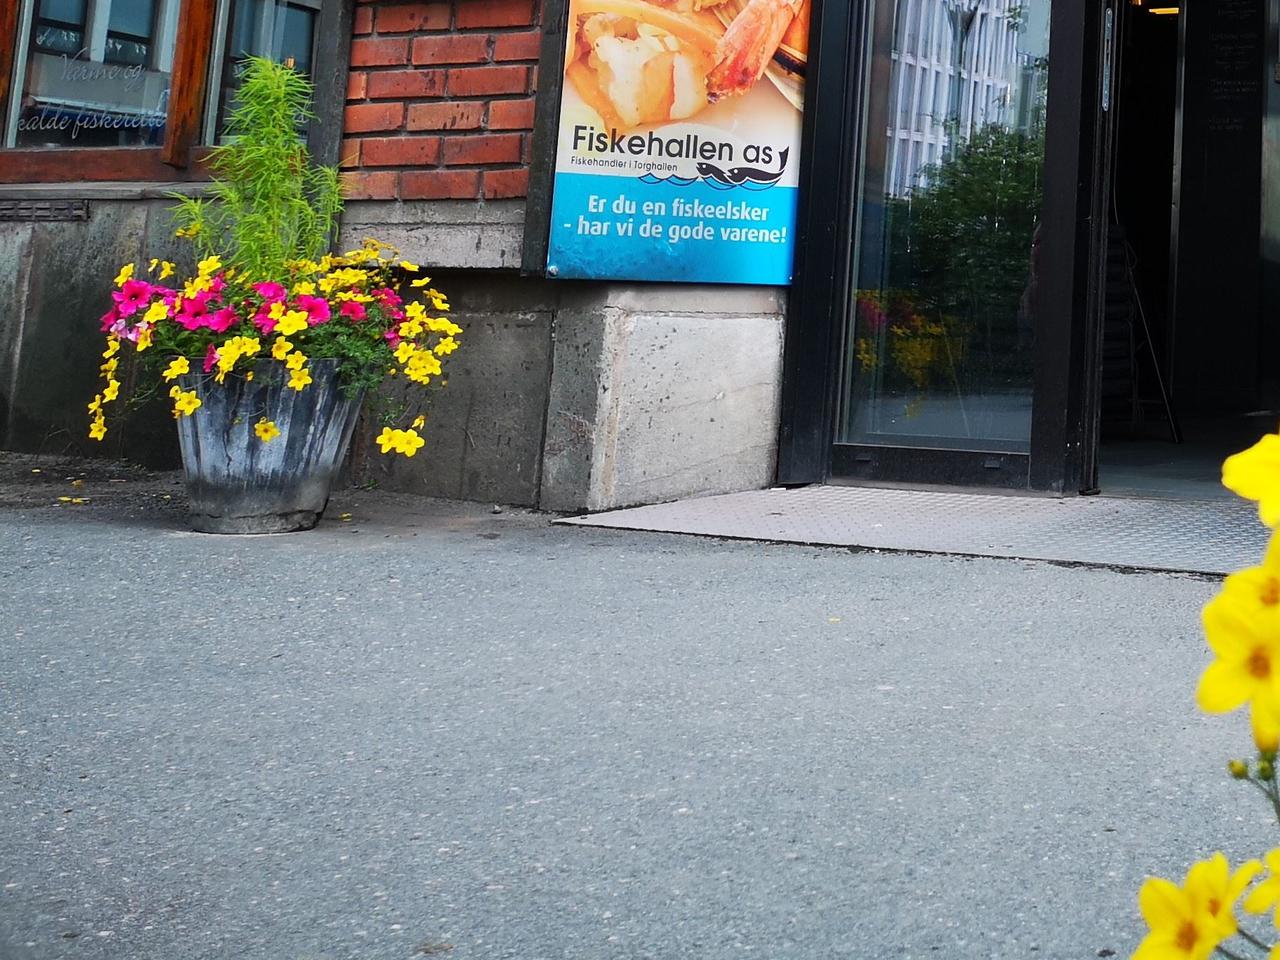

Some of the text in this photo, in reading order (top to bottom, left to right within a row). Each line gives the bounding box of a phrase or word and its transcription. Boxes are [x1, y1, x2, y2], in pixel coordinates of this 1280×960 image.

[60, 47, 145, 91] Varme og
[572, 125, 773, 164] Fiskehallen as
[570, 156, 627, 168] Fiskehandler
[634, 160, 678, 172] Torghallen
[588, 194, 769, 222] Er du en fiskeelsker
[577, 216, 610, 236] har
[616, 218, 633, 238] vi
[639, 218, 662, 238] de
[668, 221, 714, 244] gode
[720, 226, 787, 244] varene!
